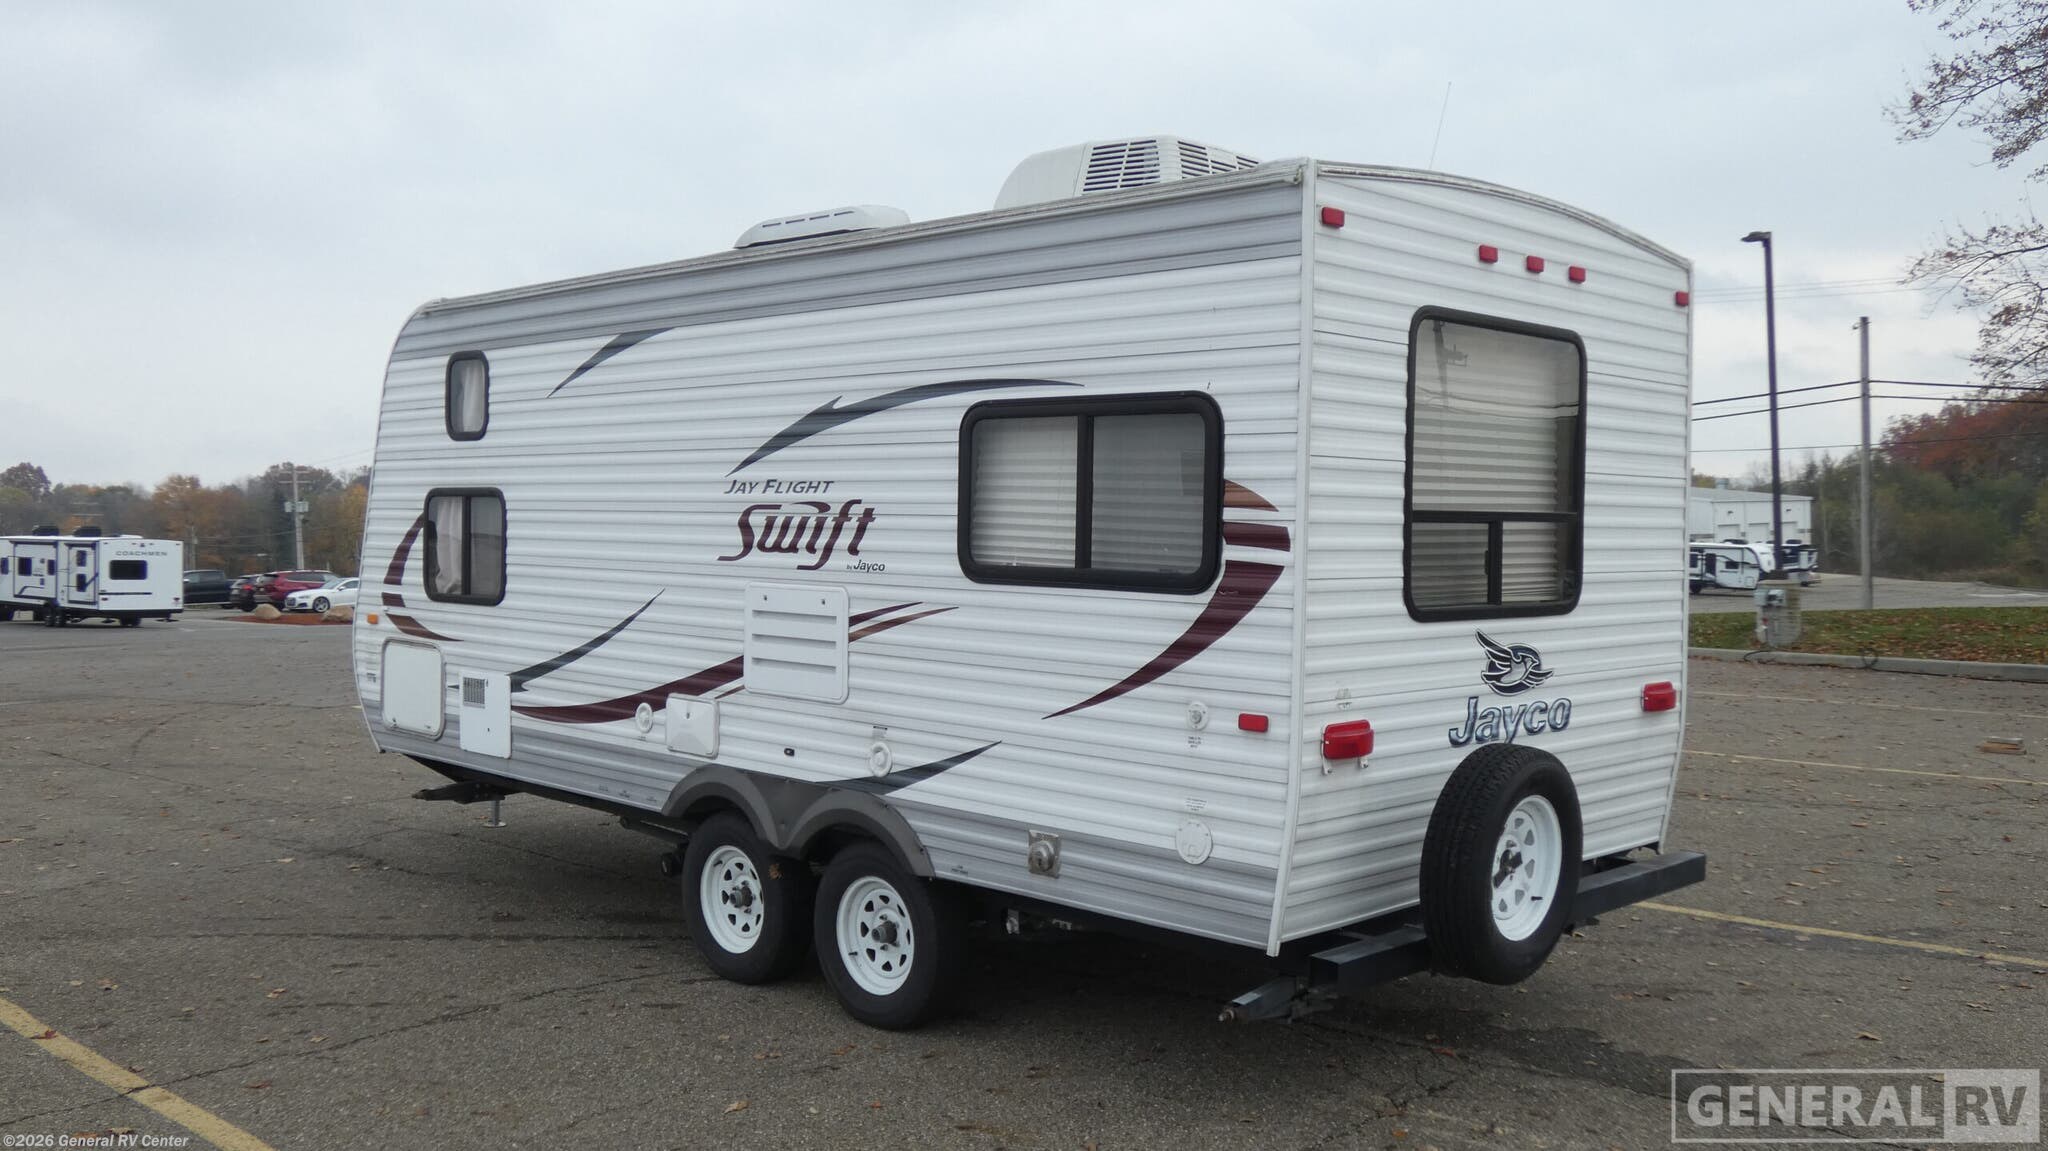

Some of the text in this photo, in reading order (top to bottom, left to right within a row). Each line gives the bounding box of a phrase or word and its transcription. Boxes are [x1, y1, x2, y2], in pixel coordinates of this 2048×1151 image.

[716, 499, 877, 571] Swift
[853, 559, 886, 573] Jayco
[1448, 696, 1573, 747] Jayco
